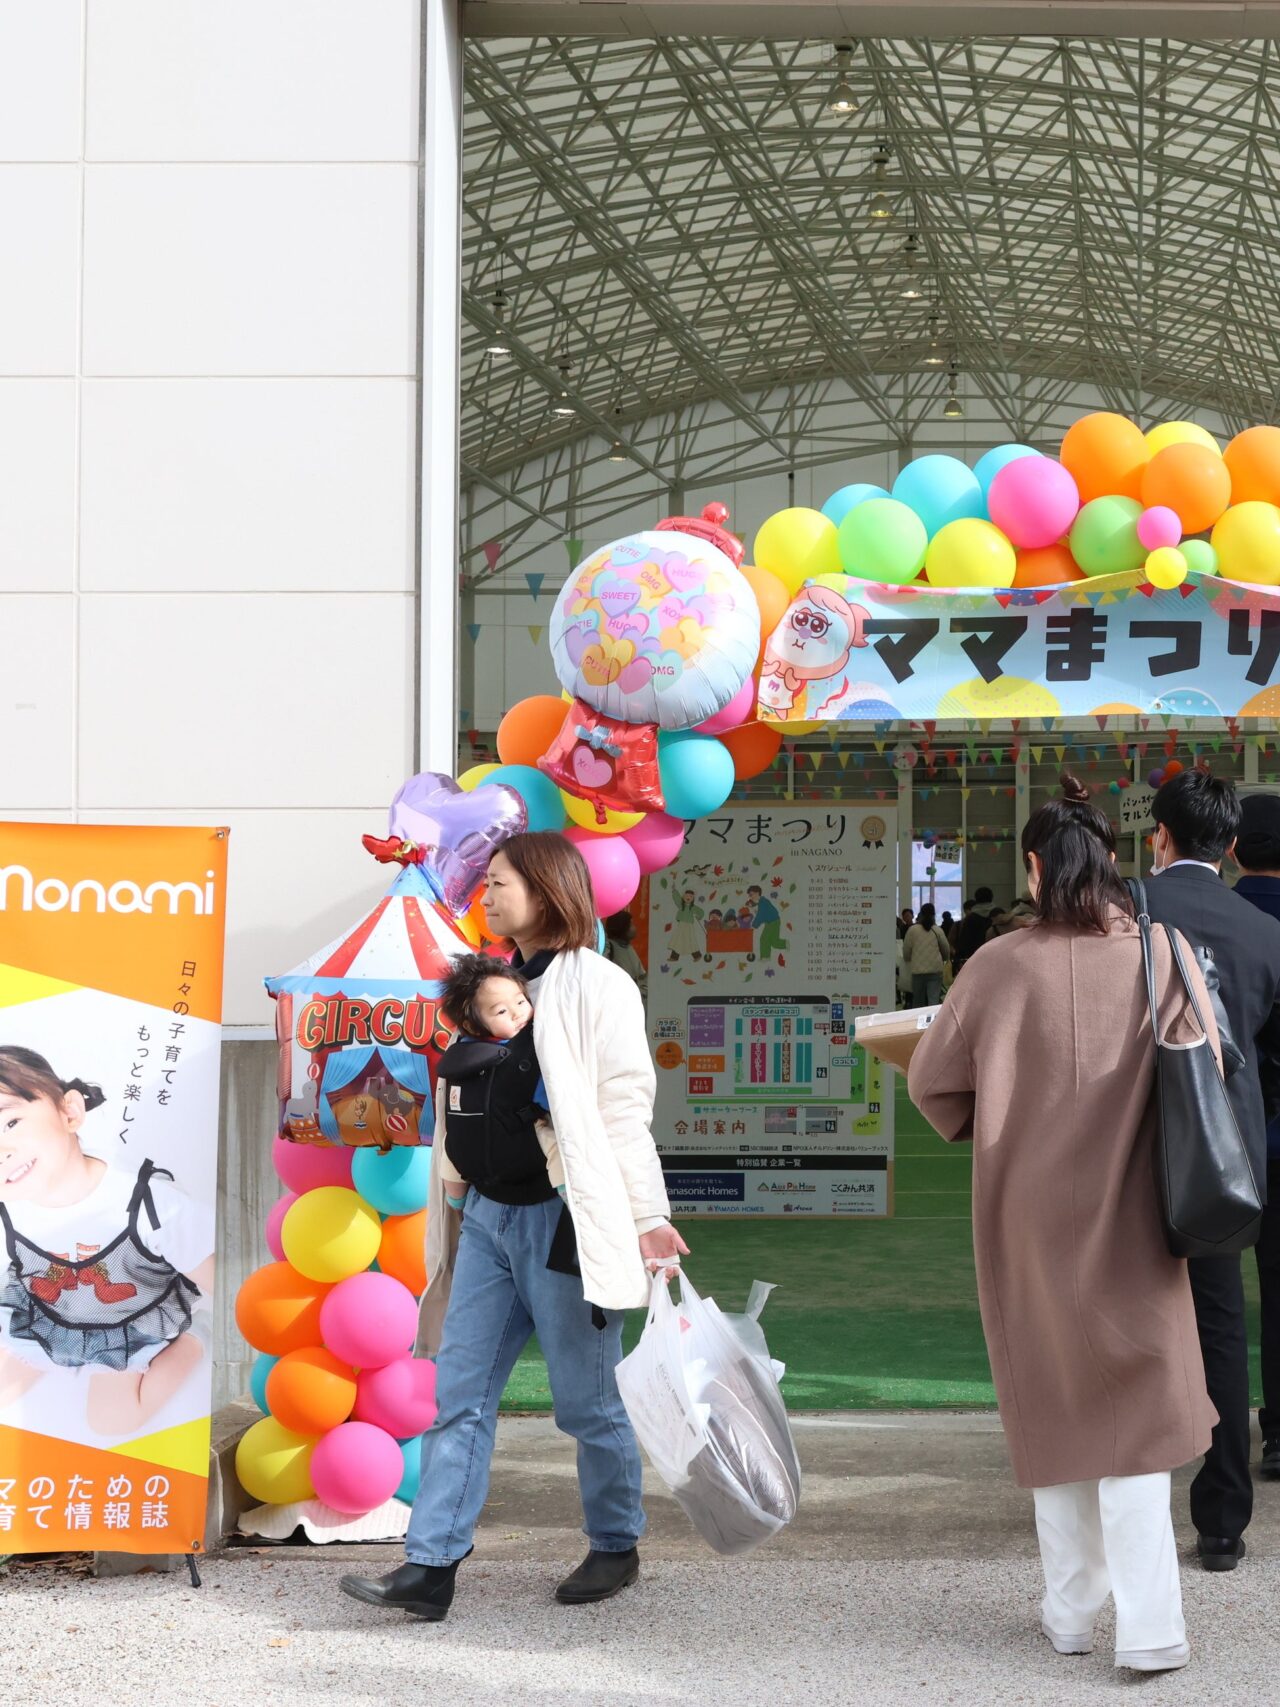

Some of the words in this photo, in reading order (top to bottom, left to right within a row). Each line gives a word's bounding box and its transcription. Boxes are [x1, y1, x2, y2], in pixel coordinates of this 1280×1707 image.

[615, 545, 641, 558] CUTIE
[641, 571, 661, 590] OMG
[601, 592, 637, 600] SWEET
[651, 666, 675, 675] OMG
[157, 960, 197, 1106] 日々の子育てを
[119, 1024, 151, 1145] もっと楽しく
[674, 1120, 746, 1135] 会場案内
[737, 1159, 767, 1167] 特別協賛
[770, 1159, 801, 1167] 企業一覧
[708, 1187, 739, 1195] Homes
[831, 1184, 875, 1193] こくみん共済
